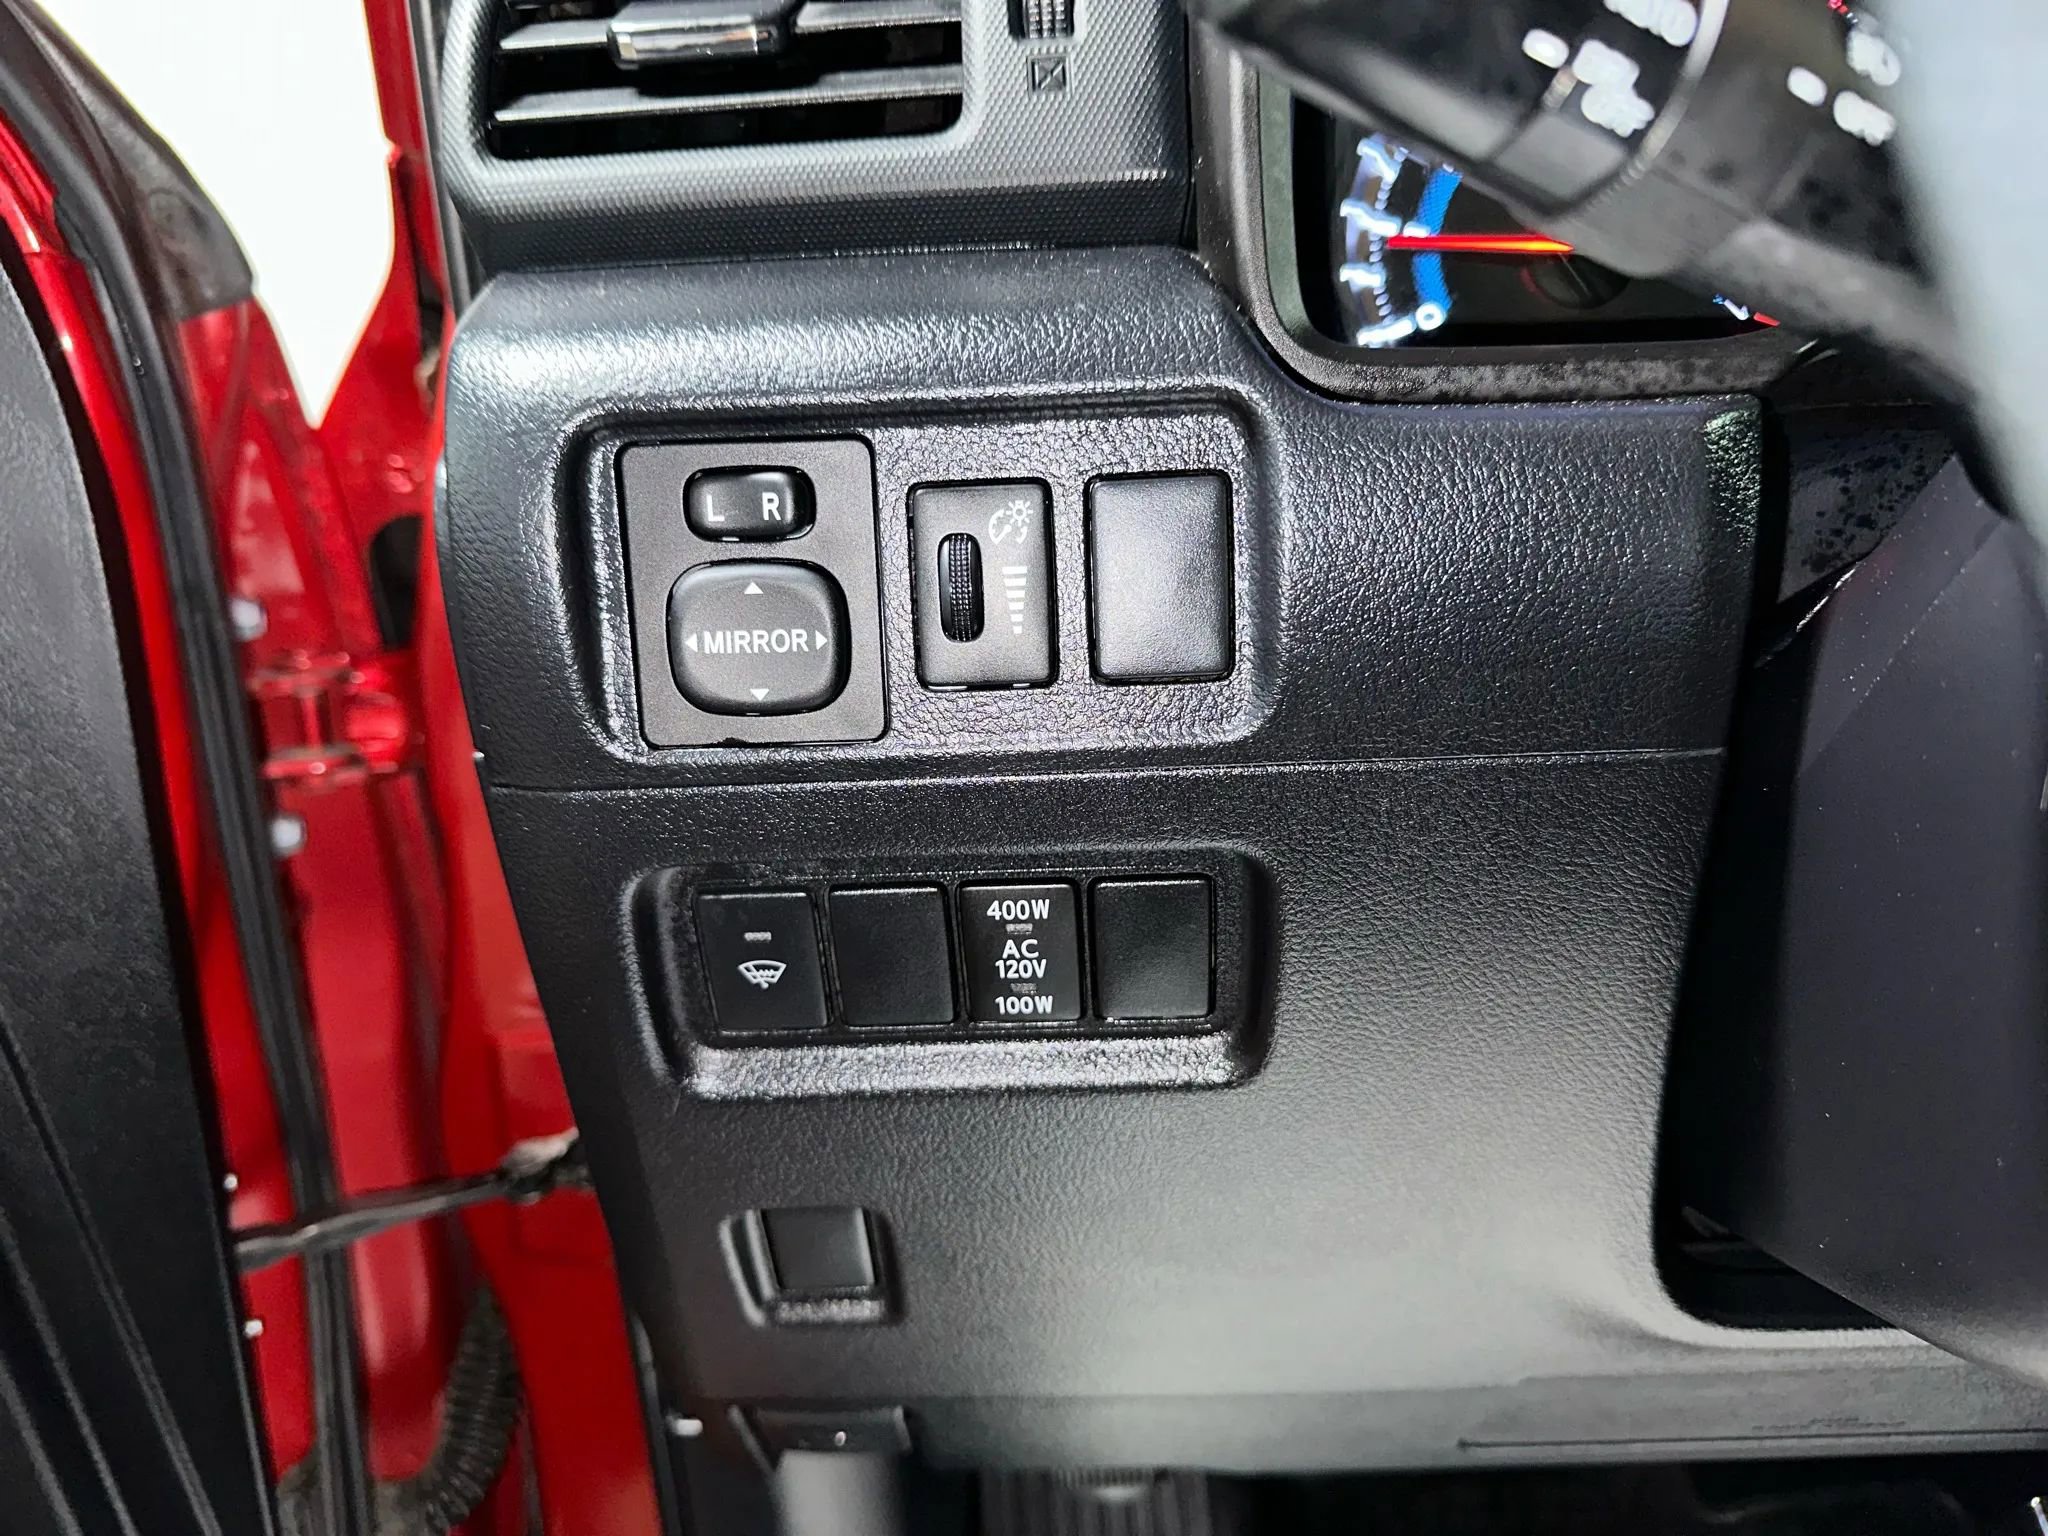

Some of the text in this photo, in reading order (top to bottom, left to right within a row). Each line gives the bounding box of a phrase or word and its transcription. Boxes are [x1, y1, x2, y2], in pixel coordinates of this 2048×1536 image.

[706, 491, 782, 522] L R
[703, 628, 809, 655] MIRROR
[986, 898, 1051, 921] 400W
[1002, 938, 1040, 960] AC
[994, 958, 1047, 979] 120V
[994, 994, 1054, 1015] 100W
